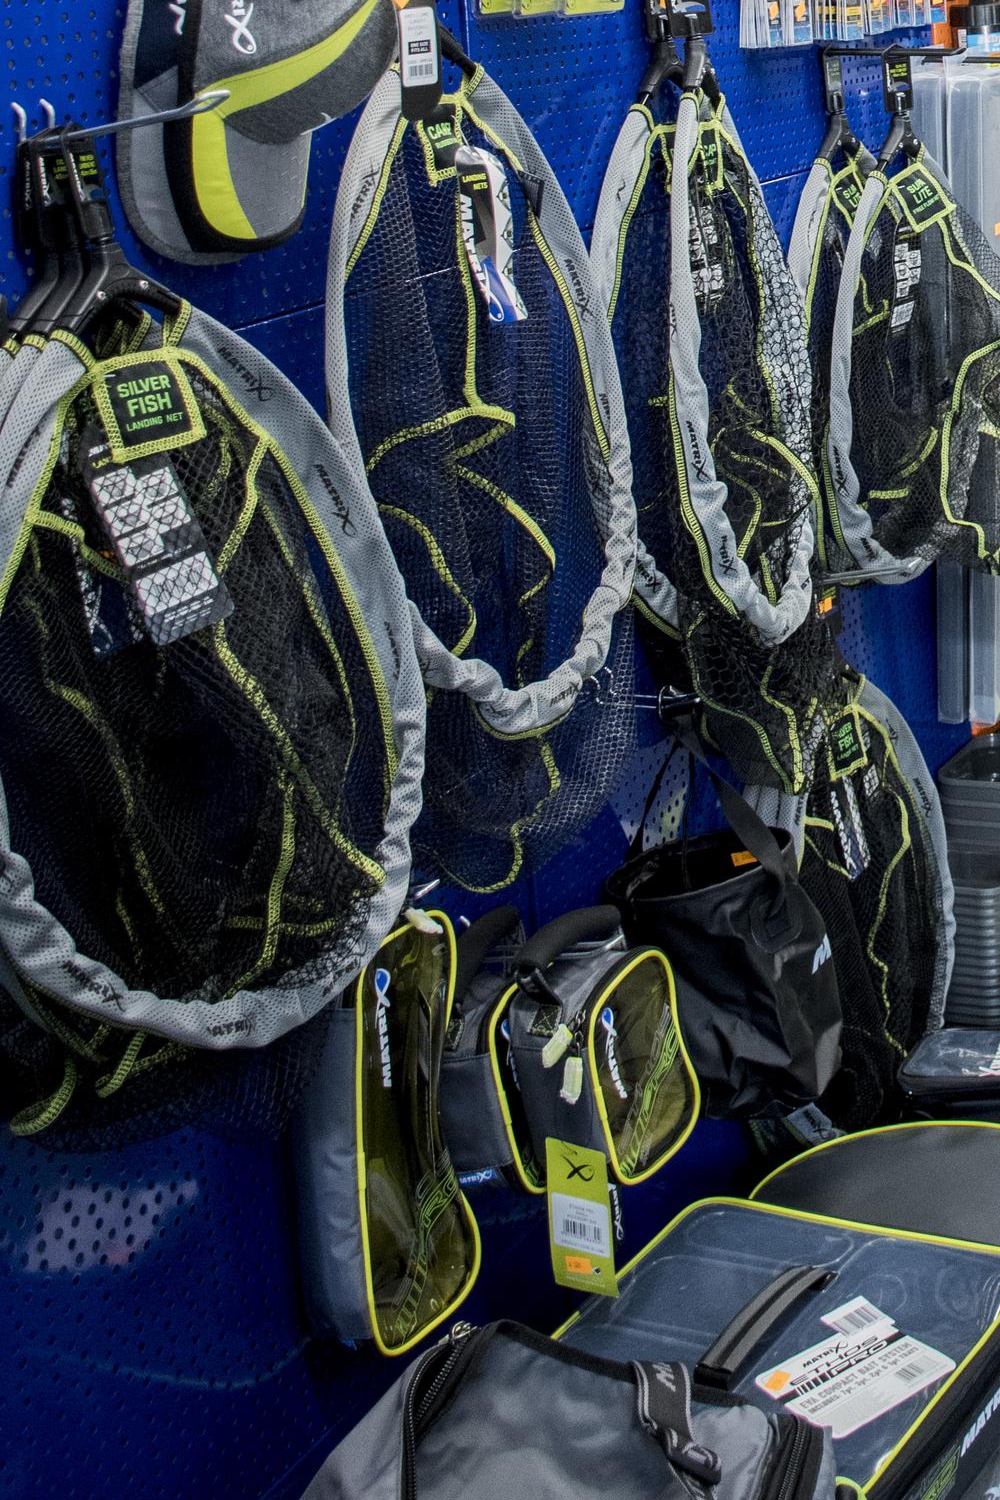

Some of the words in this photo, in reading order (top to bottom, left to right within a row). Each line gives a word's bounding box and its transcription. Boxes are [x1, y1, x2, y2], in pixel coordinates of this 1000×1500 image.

[462, 172, 487, 184] LANDING
[473, 181, 489, 191] NETS
[913, 187, 934, 204] LITE
[460, 192, 505, 322] MATRIX
[563, 257, 596, 322] MATRIX
[116, 373, 171, 399] SILVER
[217, 346, 278, 402] MATRIX
[126, 414, 163, 432] LANDING
[165, 411, 184, 425] NET
[127, 391, 172, 417] FISH
[686, 420, 712, 483] MATRIX
[312, 463, 358, 538] MATRIX
[838, 732, 854, 752] FISH
[373, 968, 393, 1088] MATRIX
[601, 1006, 629, 1100] MATRIX
[789, 1335, 879, 1386] ETHOS
[802, 1338, 850, 1369] MATRIX
[829, 1339, 888, 1379] PRO
[800, 1396, 816, 1414] EVA
[816, 1370, 859, 1398] COMPACT
[858, 1356, 879, 1376] BAIT
[879, 1341, 911, 1364] SYSTEM
